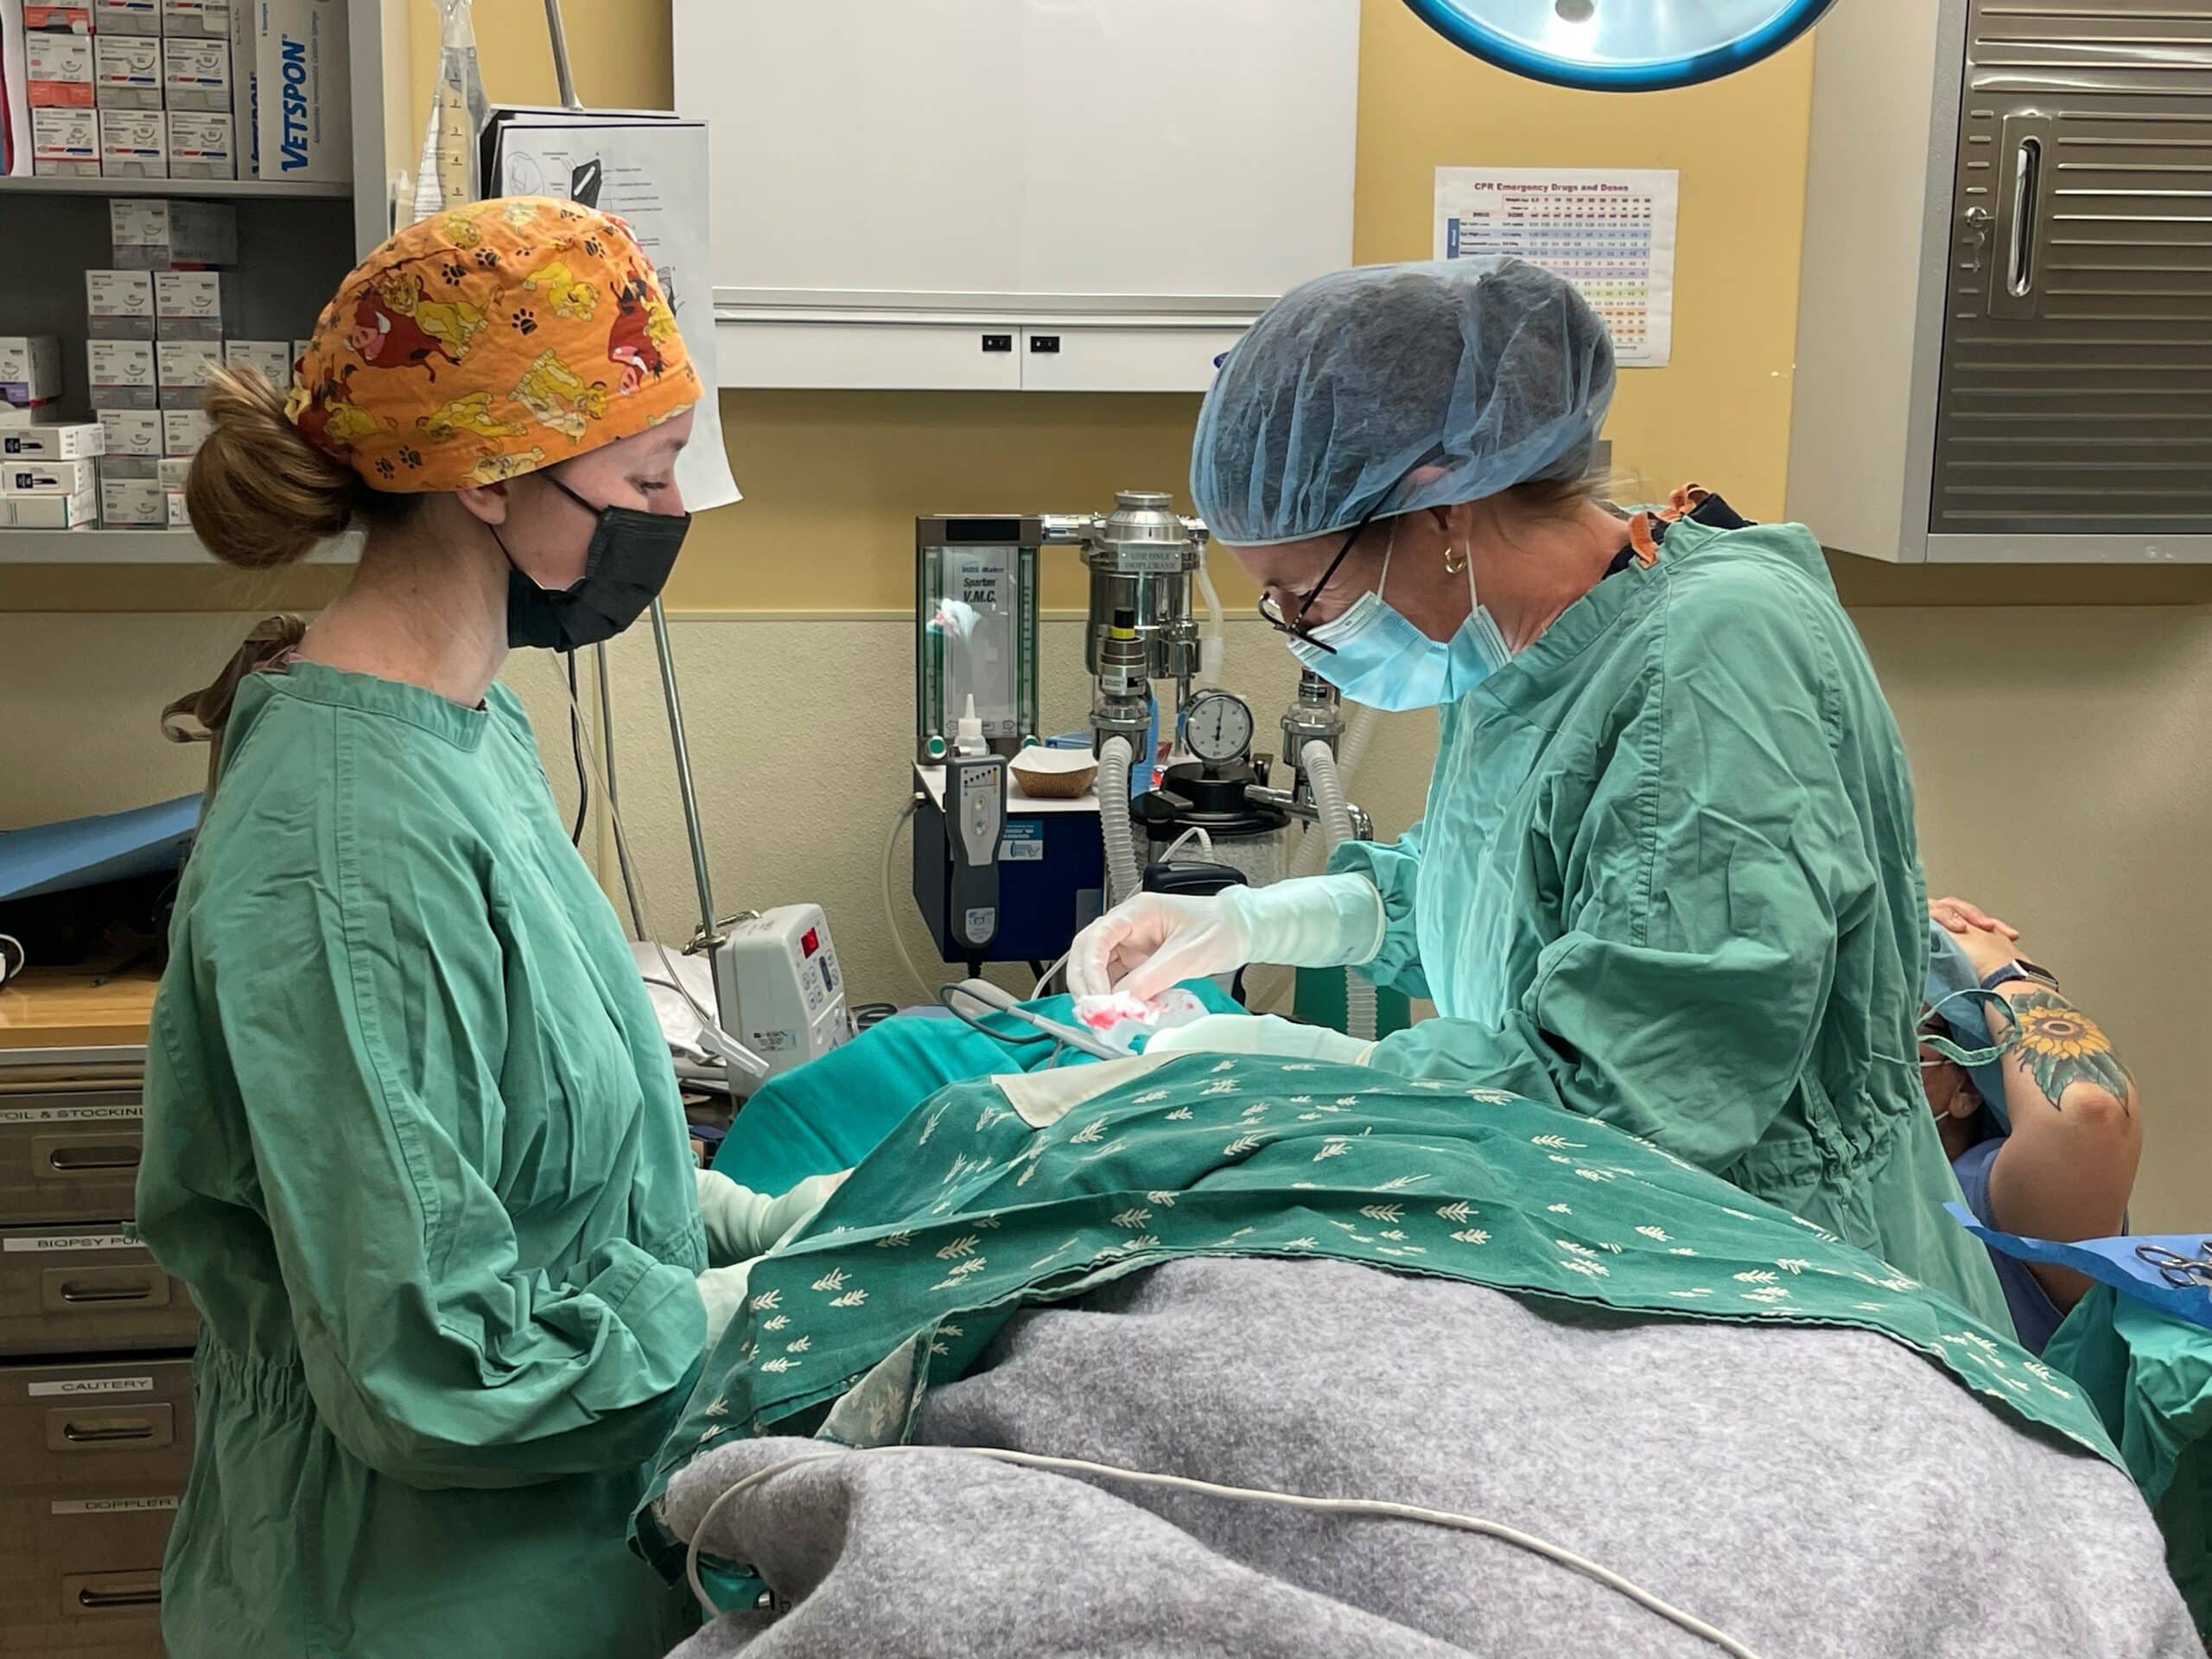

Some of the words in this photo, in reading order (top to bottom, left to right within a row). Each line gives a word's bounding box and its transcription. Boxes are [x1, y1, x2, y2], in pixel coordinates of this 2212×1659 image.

[1474, 182, 1494, 191] CPR
[1497, 183, 1548, 193] Emergency
[1551, 183, 1579, 193] Drugs
[963, 577, 996, 588] Spartan
[37, 1238, 104, 1248] BIOPSY
[61, 1381, 147, 1391] CAUTERY
[86, 1498, 171, 1510] DOPPLER
